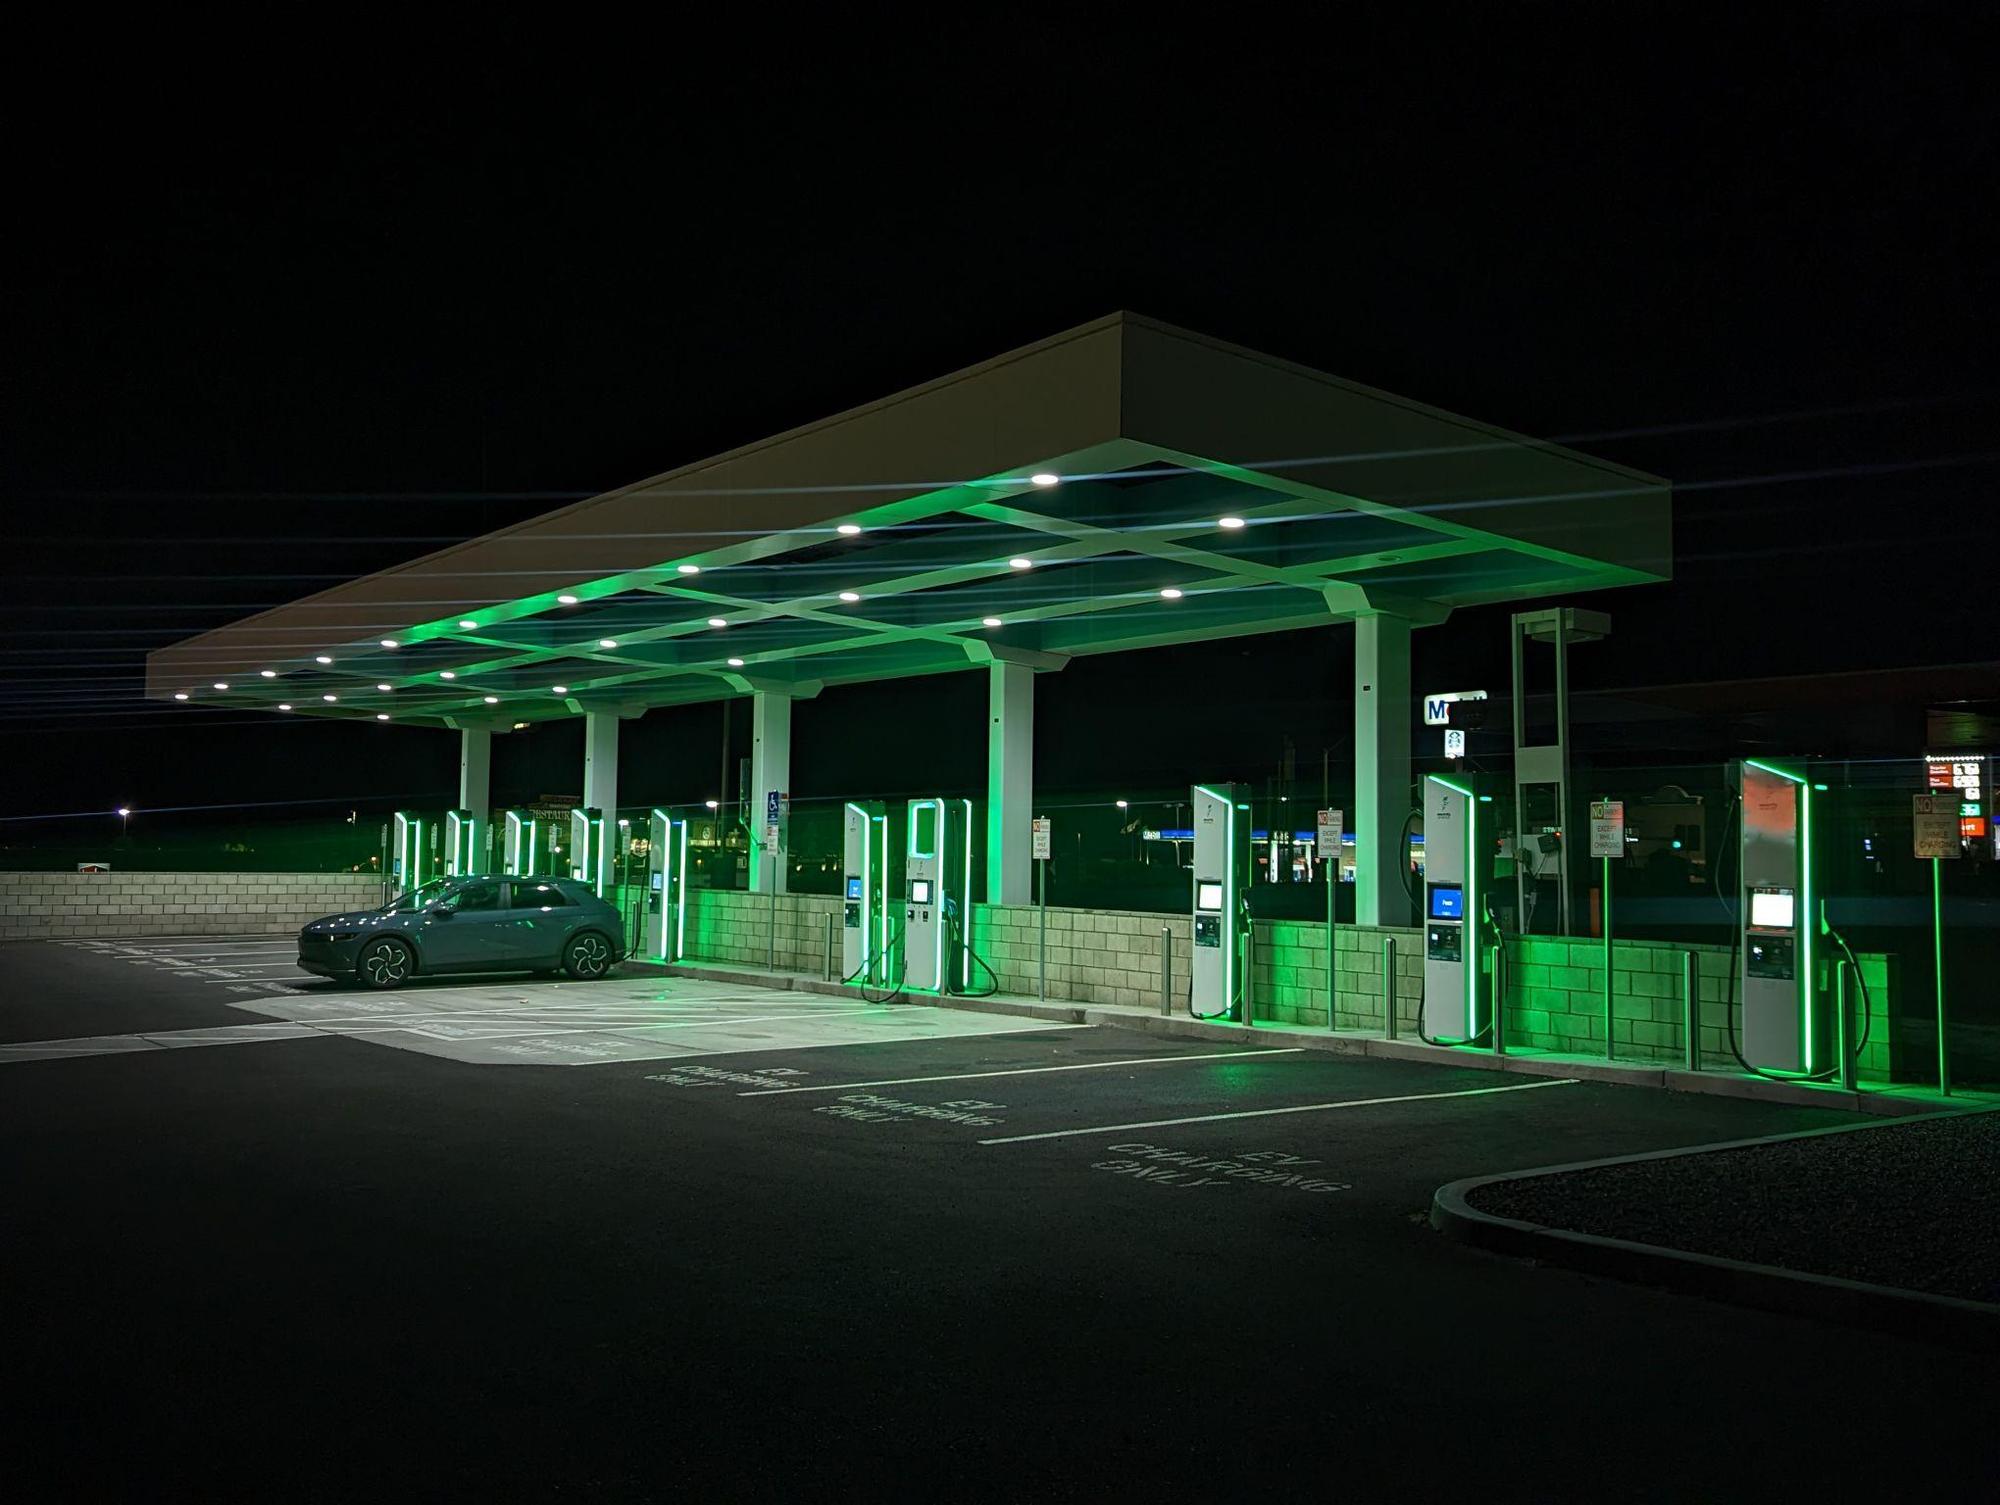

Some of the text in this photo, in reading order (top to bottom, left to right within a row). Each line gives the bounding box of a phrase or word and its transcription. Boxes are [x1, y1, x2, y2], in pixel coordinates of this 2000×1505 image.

[1592, 805, 1604, 818] NO
[1597, 825, 1617, 833] EXCEPT
[812, 1105, 914, 1123] ONLY
[837, 1094, 1006, 1127] CHARGING
[1107, 1143, 1352, 1192] CHARGING
[1236, 1151, 1324, 1166] EV
[1091, 1160, 1231, 1188] ONLY
